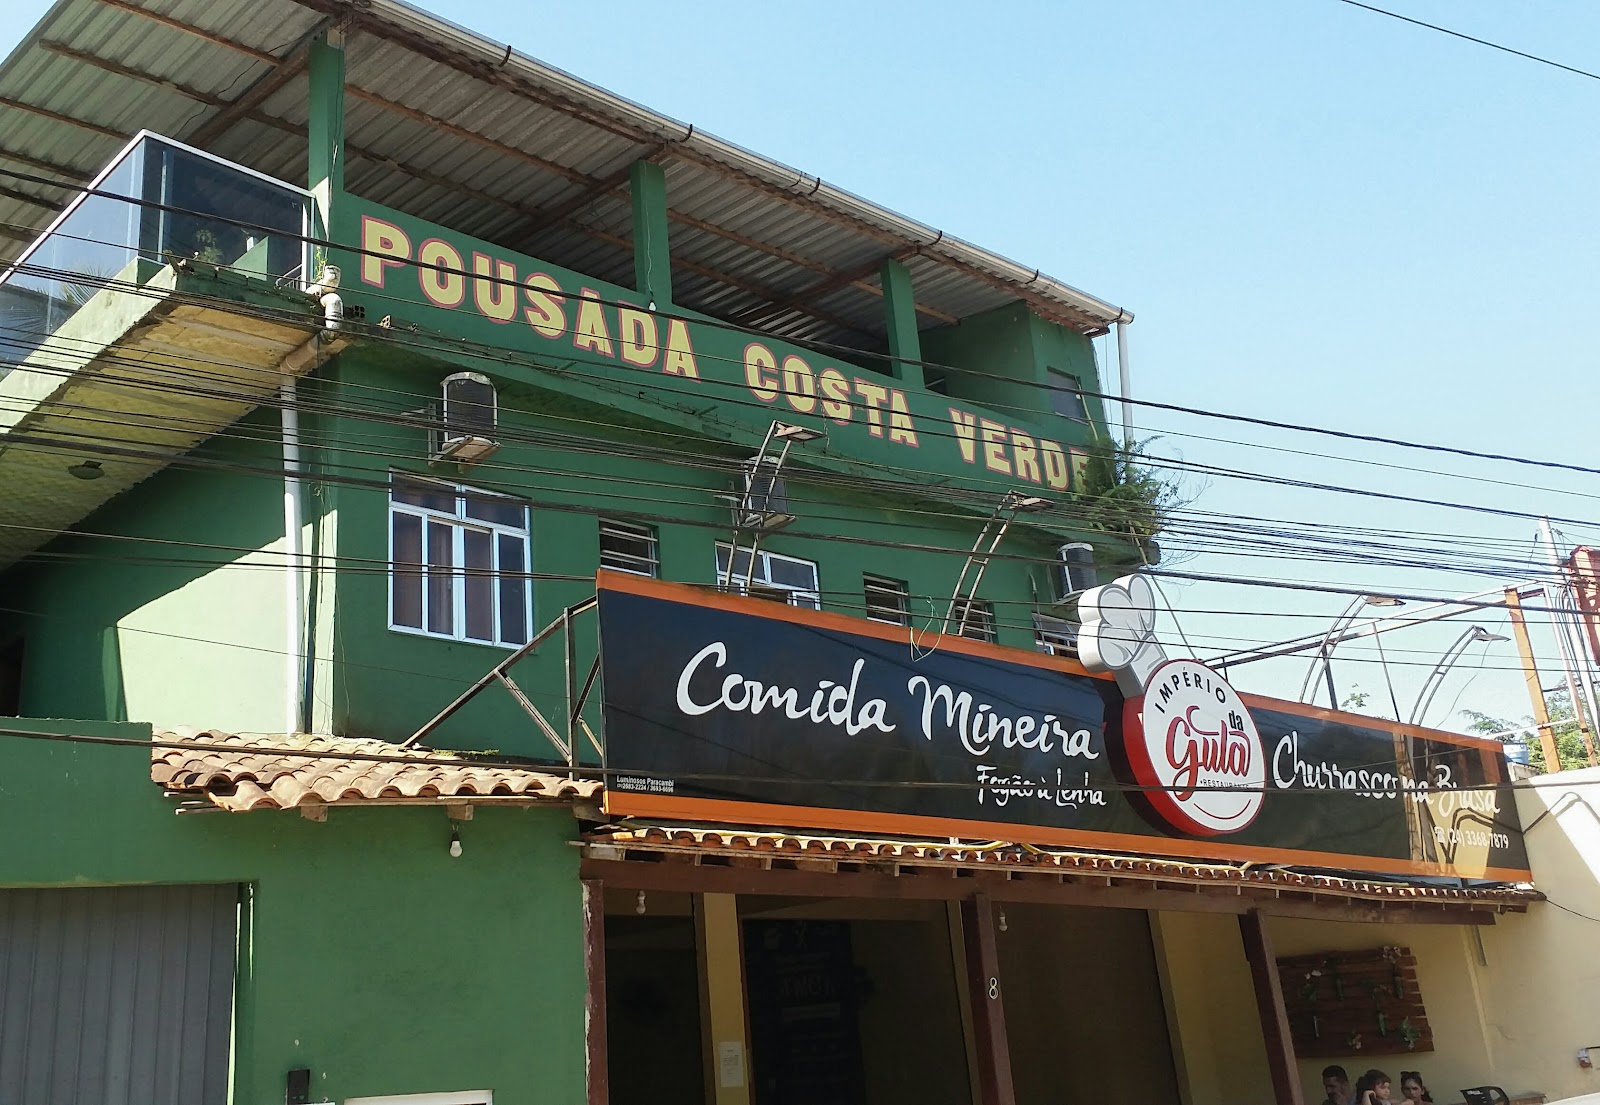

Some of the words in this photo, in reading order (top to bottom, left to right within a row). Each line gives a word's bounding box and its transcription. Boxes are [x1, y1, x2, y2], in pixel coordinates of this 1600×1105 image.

[361, 215, 701, 383] POUSADA
[743, 342, 919, 448] COSTA
[676, 641, 896, 736] Comida
[907, 675, 1100, 760] Mineira
[1154, 666, 1227, 715] IMPÉRIO
[1228, 710, 1244, 732] da
[976, 765, 1036, 807] Fogão
[1056, 767, 1108, 810] Lenha
[1272, 729, 1399, 799] Churrasco
[1402, 775, 1434, 805] na
[1435, 764, 1501, 818] Brasa
